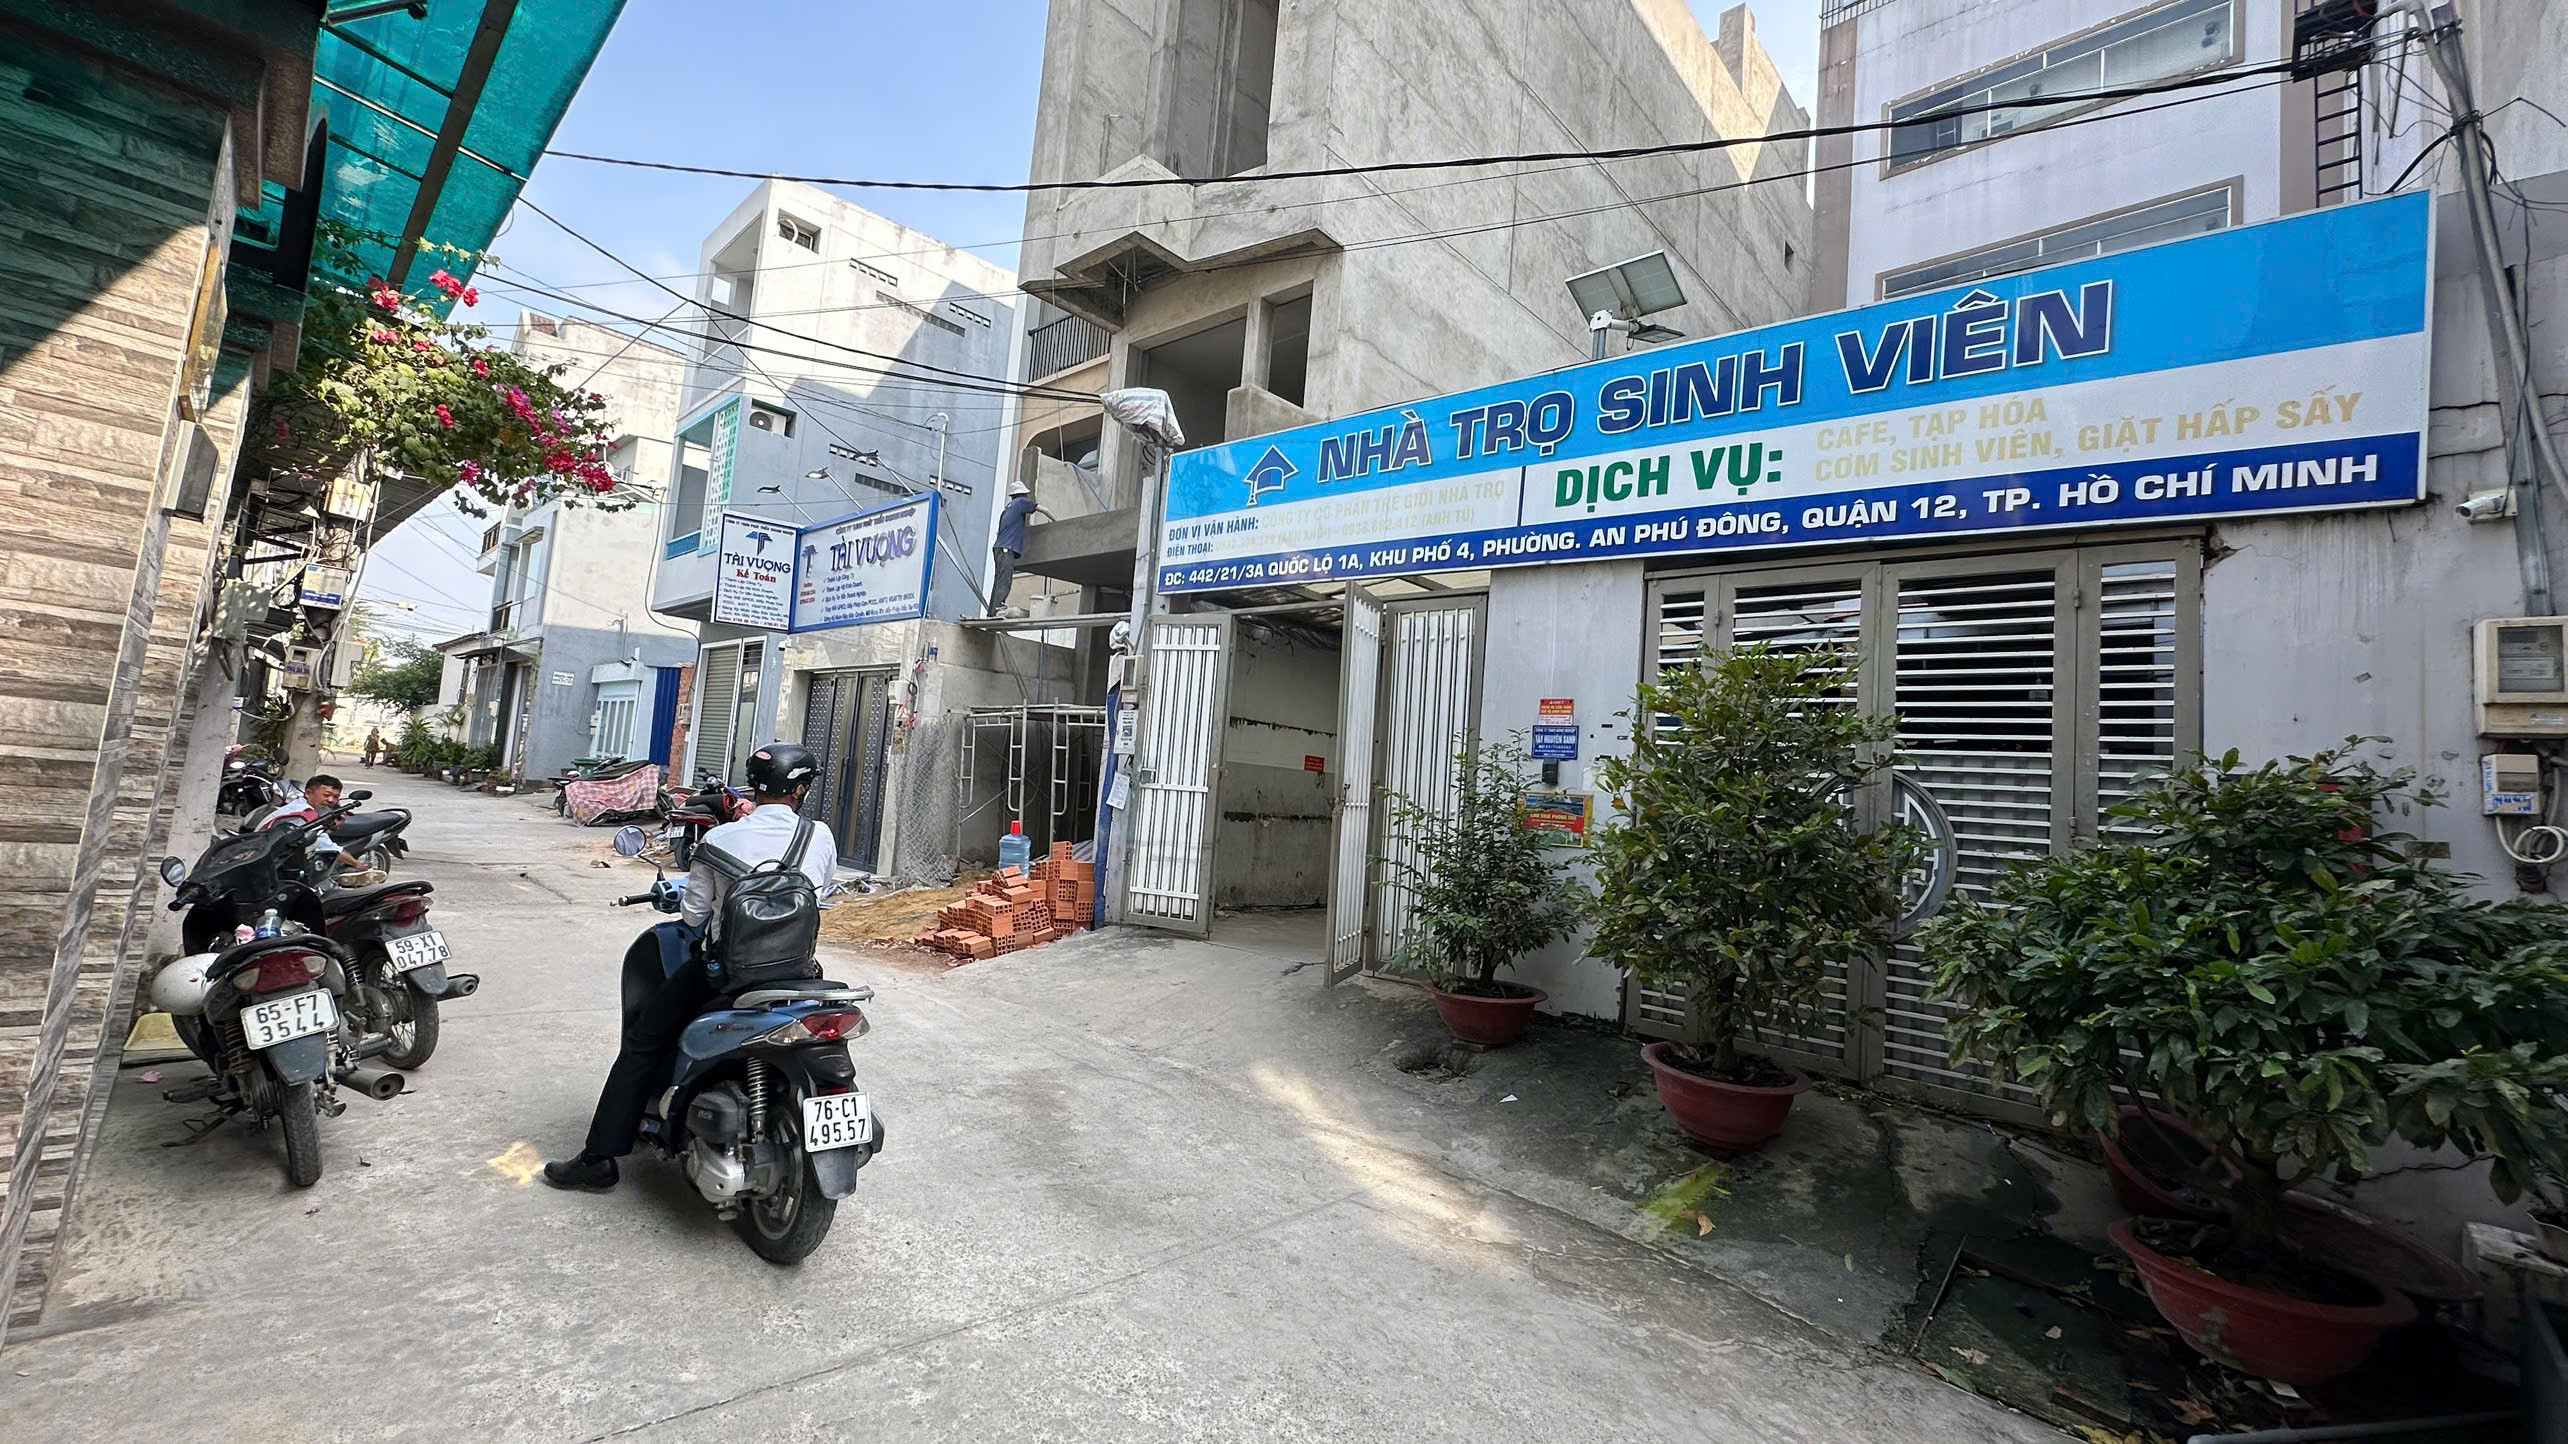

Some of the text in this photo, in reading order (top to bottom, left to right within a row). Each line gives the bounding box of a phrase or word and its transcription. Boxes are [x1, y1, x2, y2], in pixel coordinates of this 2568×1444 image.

[1317, 280, 2113, 483] NHÀ TRỌ SINH VIÊN
[1815, 385, 2363, 482] CƠM SINH VIÊN, GIẶT HẤP SẤY
[1817, 398, 2047, 451] CAFE, TẠP HÓA
[1554, 442, 1783, 513] DỊCH VỤ:
[1165, 571, 1186, 586] ĐC:
[1188, 564, 1264, 585] 442/21/3A
[1268, 554, 1309, 576] QUỐC
[1313, 553, 1333, 575] LỘ
[1338, 553, 1363, 571] 1A,
[1369, 547, 1407, 567] KHU
[1411, 539, 1452, 563] PHỐ
[1456, 542, 1475, 561] 4,
[1589, 525, 1625, 548] AN
[1634, 515, 1688, 545] PHÚ
[1696, 511, 1789, 539] ĐÔNG,
[1801, 501, 1897, 530] QUẬN
[1912, 494, 1967, 522] 12,
[1983, 487, 2040, 512] TP.
[2058, 473, 2119, 508] HỒ
[2134, 463, 2217, 501] CHÍ
[2231, 454, 2378, 493] MINH
[1168, 527, 1189, 542] ĐƠN
[1192, 525, 1201, 541] VỊ
[1204, 519, 1224, 539] VẬN
[1226, 515, 1259, 534] HÀNH:
[724, 552, 791, 574] TÀI VƯỢNG
[830, 535, 852, 572] TÀI
[1167, 541, 1214, 558] ĐIỆN THOẠI:
[754, 572, 776, 583] Toán
[395, 934, 437, 954] 59-X1
[255, 994, 318, 1024] 65-F7
[258, 1012, 325, 1043] 3544
[813, 1098, 858, 1123] 76-C1
[809, 1118, 867, 1147] 495.57
